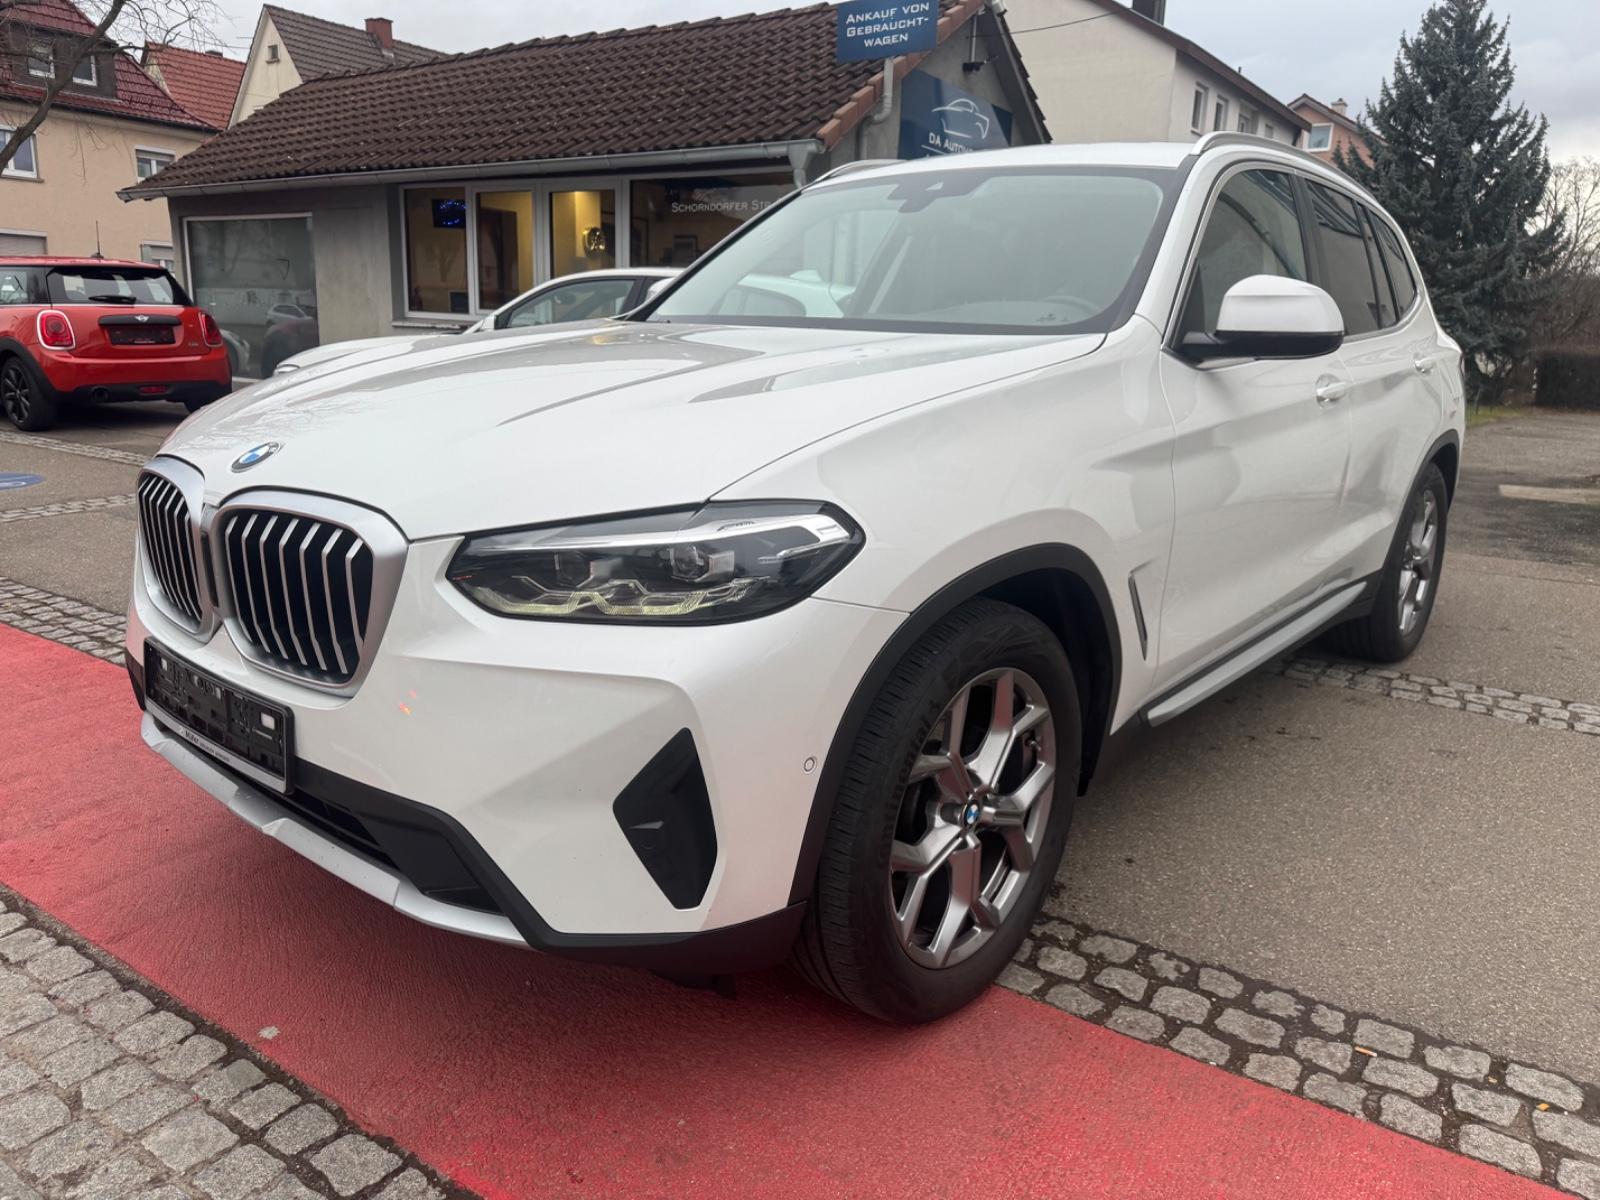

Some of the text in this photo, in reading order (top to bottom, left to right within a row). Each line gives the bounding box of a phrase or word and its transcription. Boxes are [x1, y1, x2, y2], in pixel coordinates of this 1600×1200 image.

[846, 3, 929, 24] ANKAUF VON
[847, 17, 929, 37] GEBRAUCHT-
[864, 33, 908, 48] WAGEN
[929, 132, 941, 147] DA
[672, 200, 772, 213] SCHORNDORFER STR
